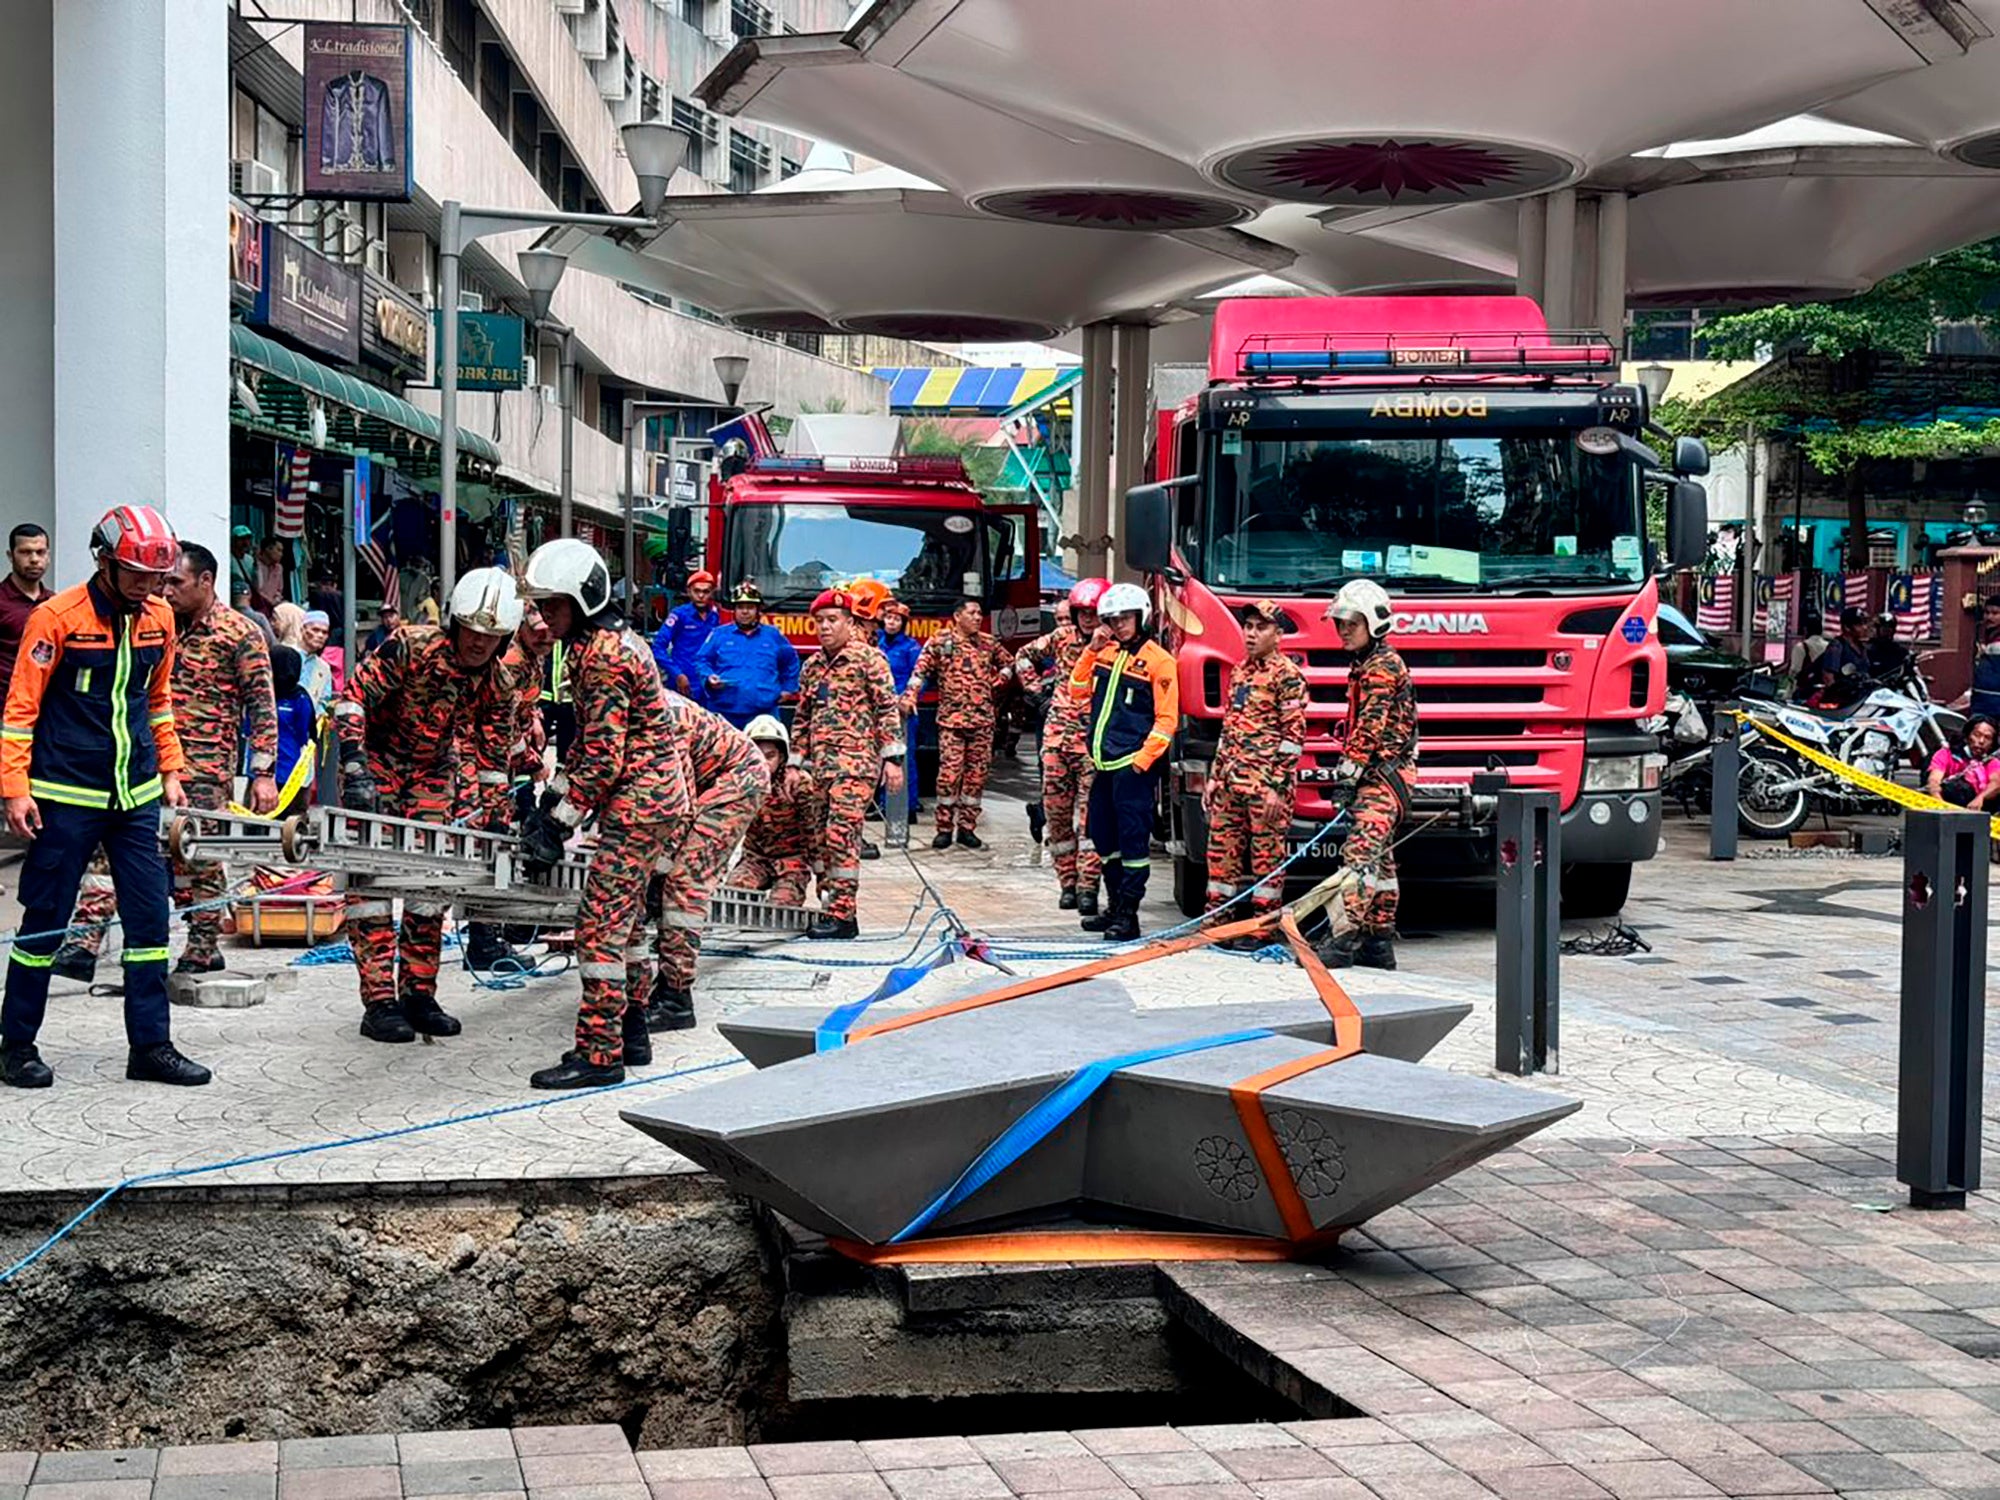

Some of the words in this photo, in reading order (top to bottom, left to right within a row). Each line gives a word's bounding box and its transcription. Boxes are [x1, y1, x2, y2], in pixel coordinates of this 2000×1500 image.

[1395, 350, 1460, 363] BOMBA
[491, 367, 519, 382] ALI
[849, 459, 896, 472] BOMBA
[1391, 613, 1489, 634] CANIA
[1301, 769, 1313, 781] P
